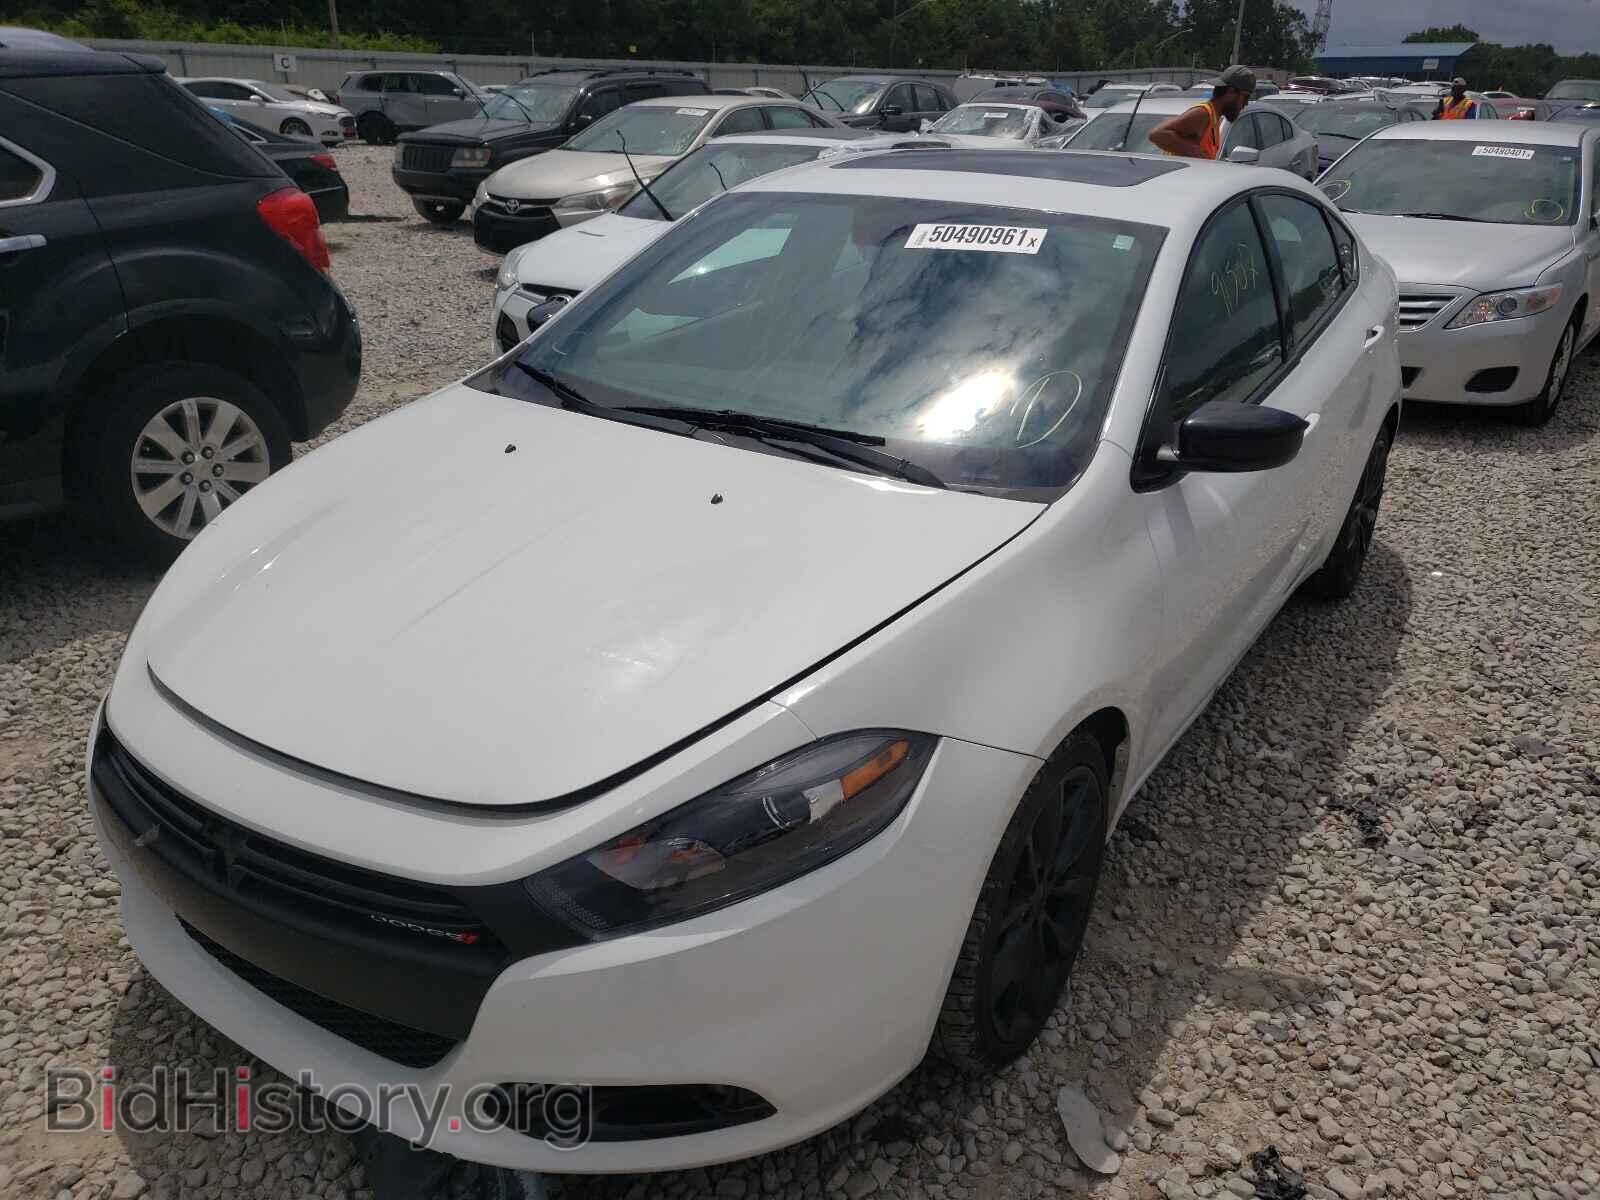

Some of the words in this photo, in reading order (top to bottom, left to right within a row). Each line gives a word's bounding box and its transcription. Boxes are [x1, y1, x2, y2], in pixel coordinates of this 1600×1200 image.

[280, 57, 289, 69] C
[929, 225, 1028, 247] 50490961
[370, 914, 463, 941] DODGE
